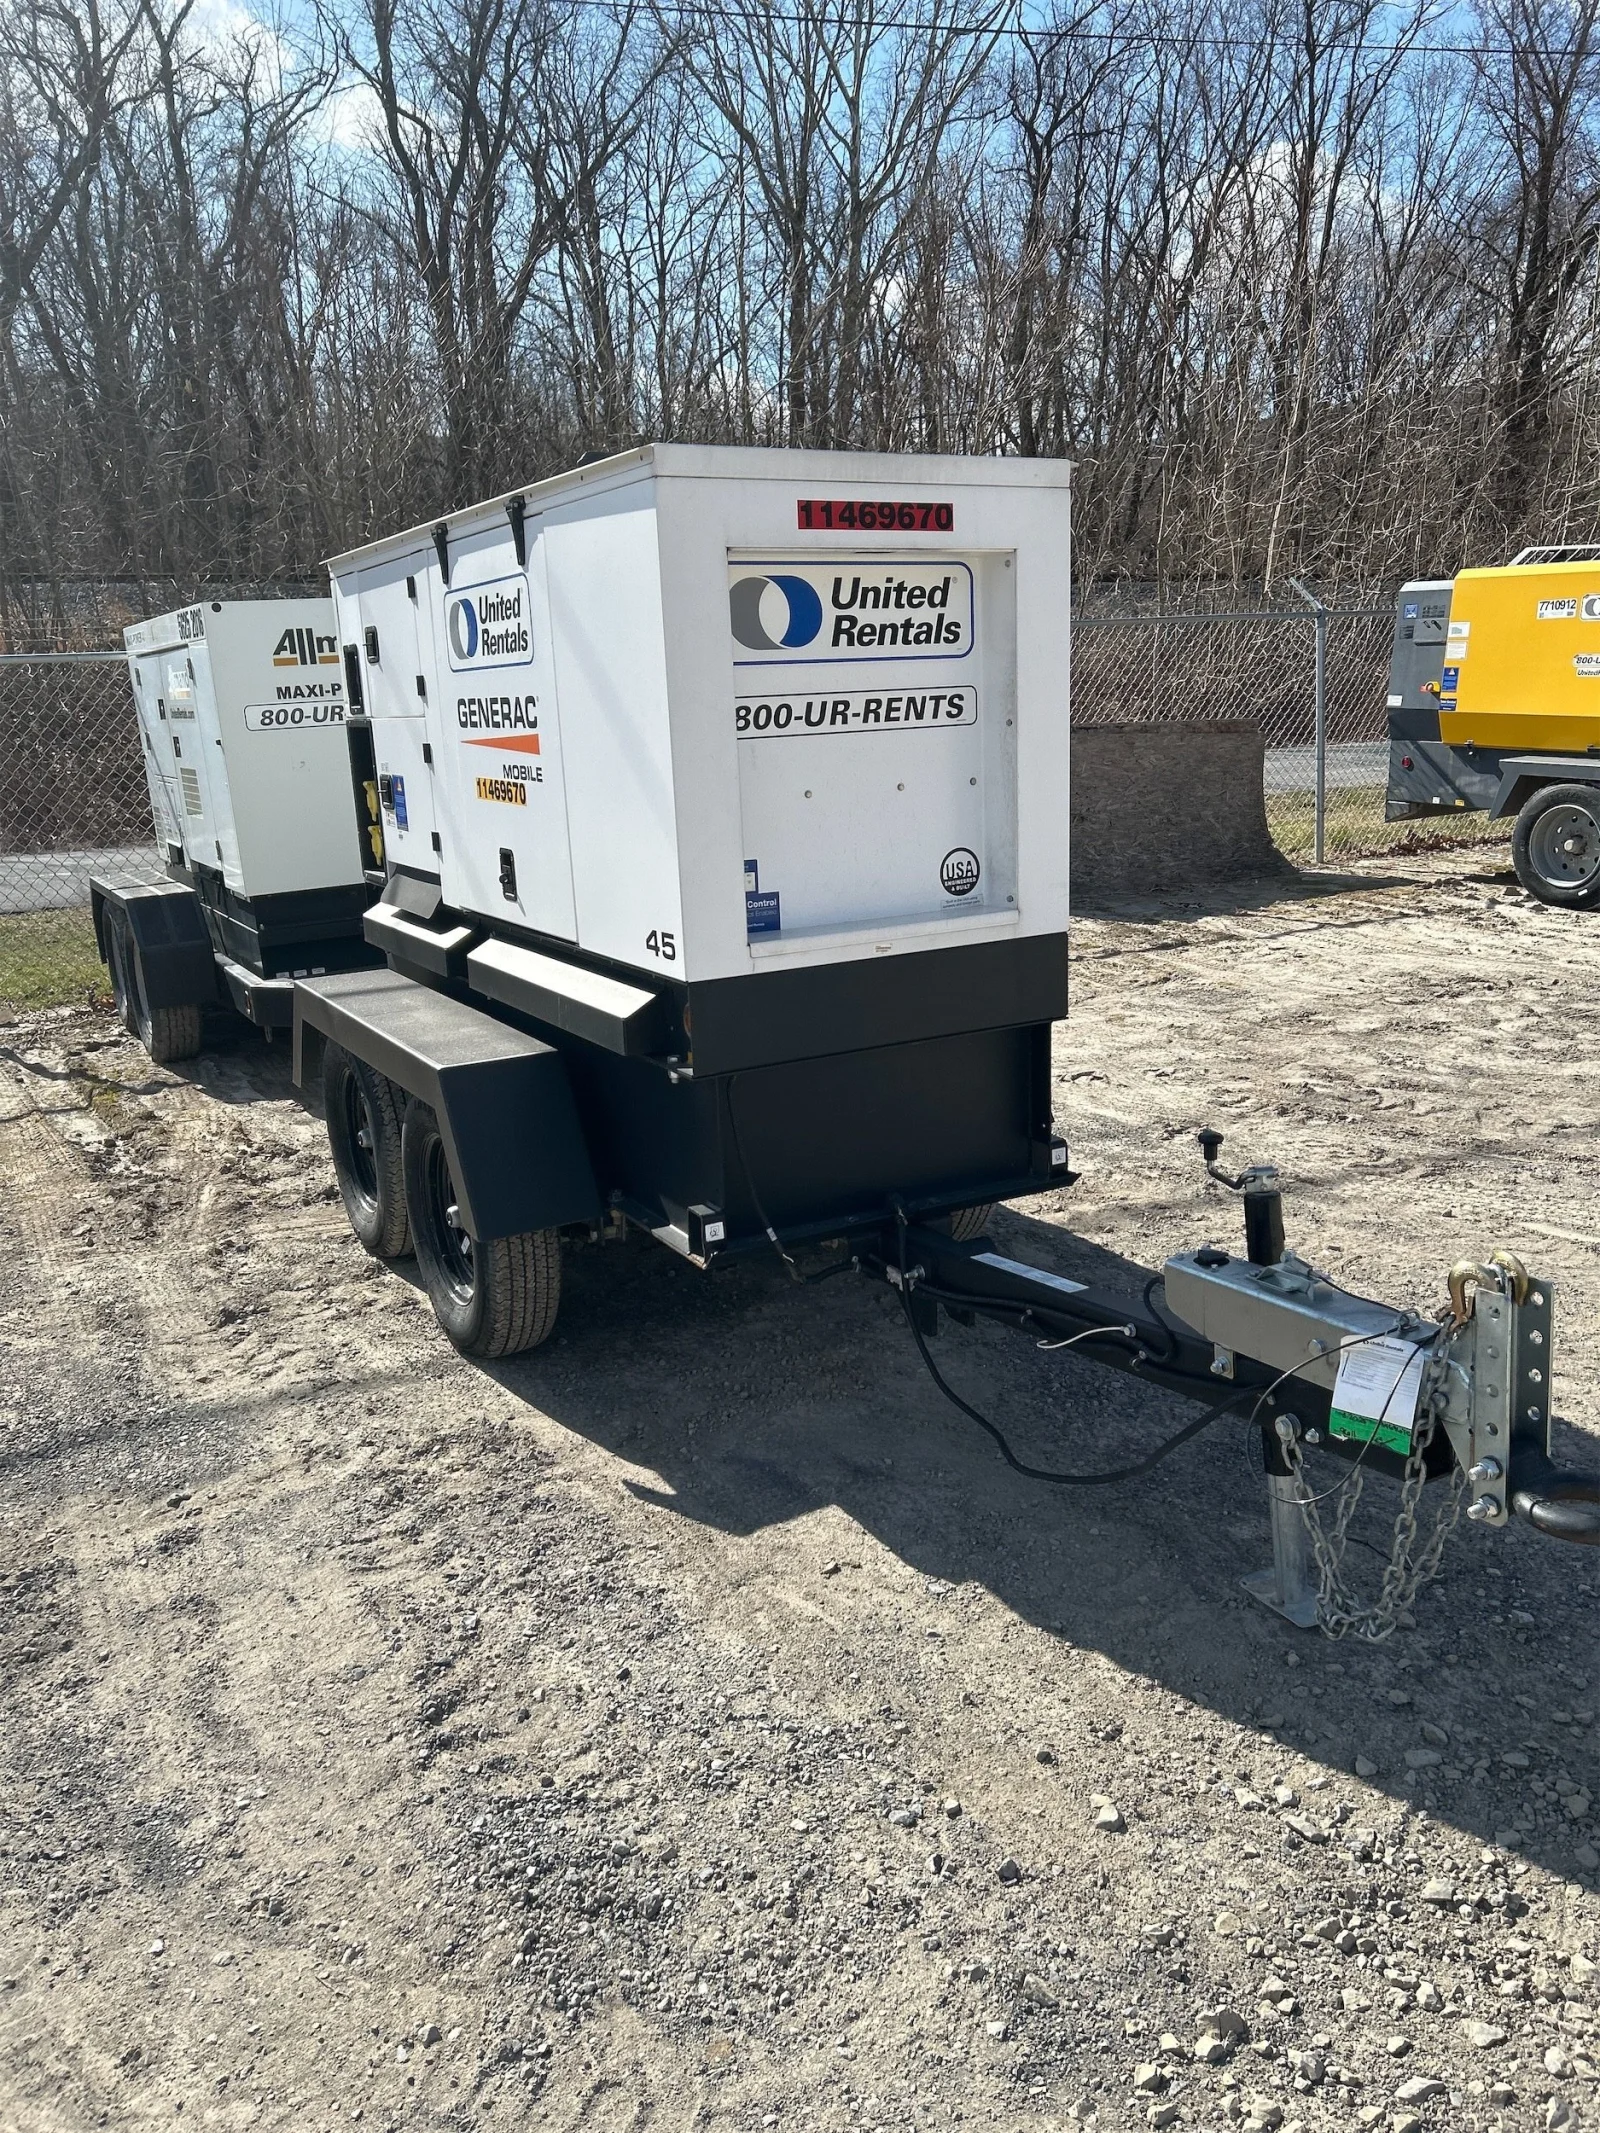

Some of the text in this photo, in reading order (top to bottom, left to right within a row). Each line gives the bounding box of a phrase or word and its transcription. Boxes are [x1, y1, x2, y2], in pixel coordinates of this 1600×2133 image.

[799, 502, 953, 529] 11469670
[478, 588, 522, 625] United
[831, 576, 952, 610] United
[1539, 599, 1577, 611] 7710912
[481, 622, 528, 656] Rentals
[831, 612, 962, 648] Rentals
[276, 683, 342, 700] MAXI-P
[457, 696, 538, 730] GENERAC
[735, 693, 965, 732] 800-UR-RENTS
[502, 764, 543, 783] MOBILE
[476, 778, 526, 805] 11469670
[946, 860, 974, 879] USA
[747, 898, 777, 908] Control
[646, 929, 676, 961] 45
